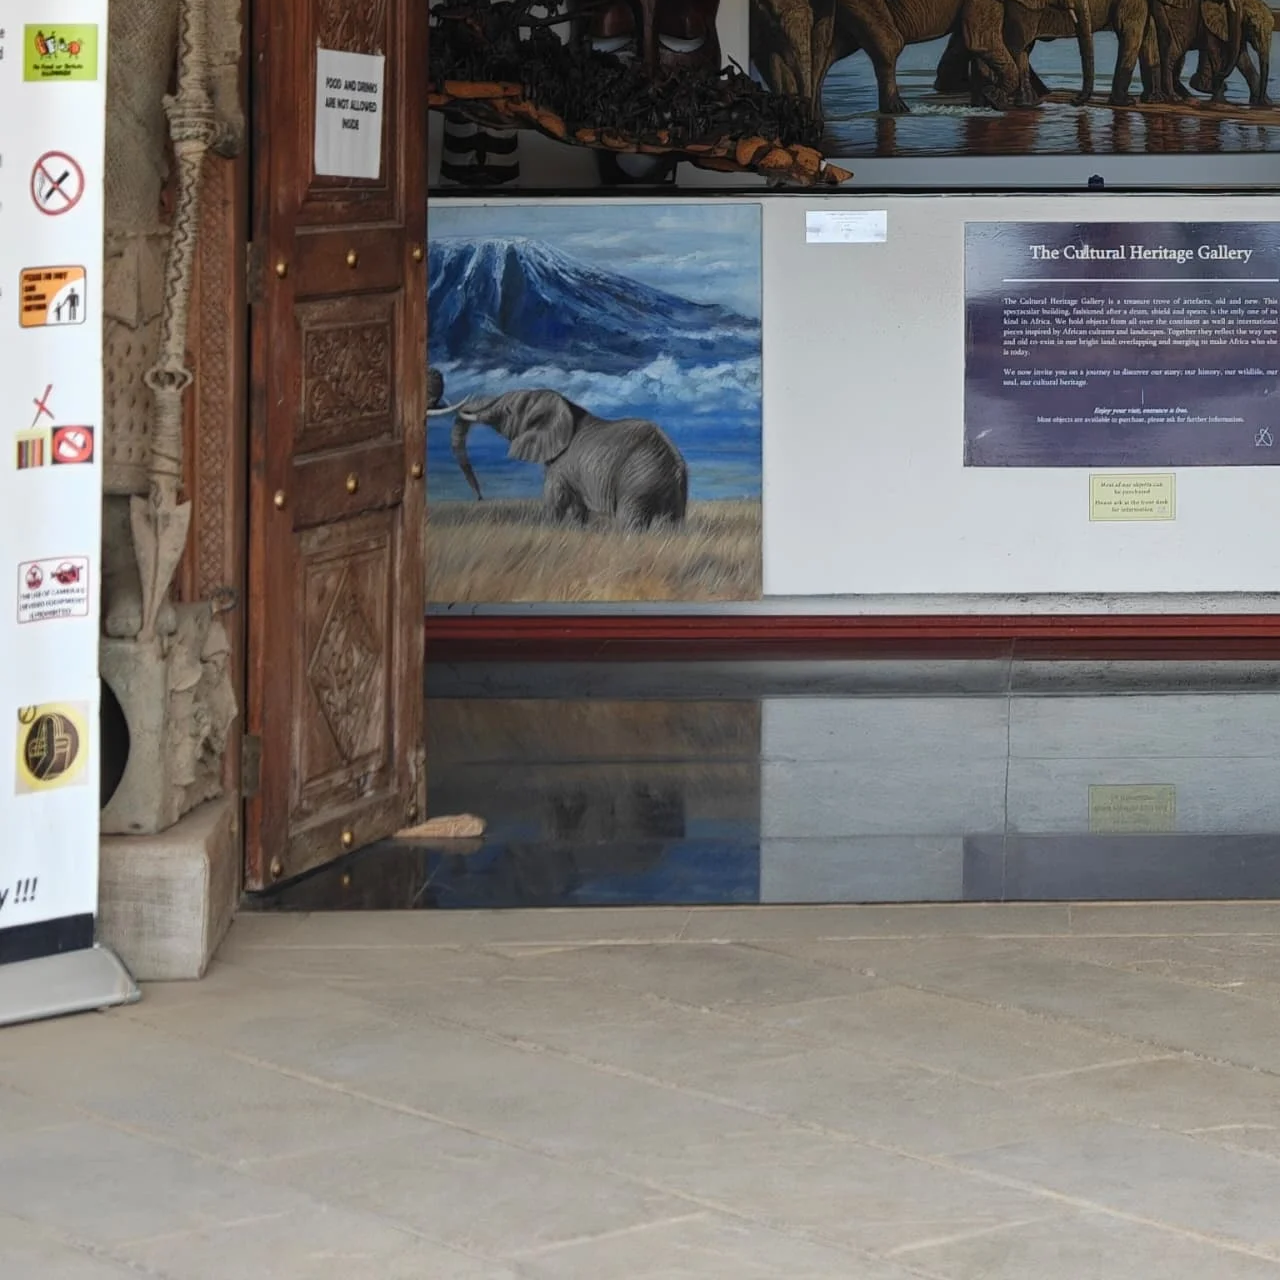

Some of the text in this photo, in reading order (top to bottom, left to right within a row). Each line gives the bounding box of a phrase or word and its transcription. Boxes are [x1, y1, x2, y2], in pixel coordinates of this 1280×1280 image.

[1030, 244, 1252, 263] The Cultural Heritage Gallery
